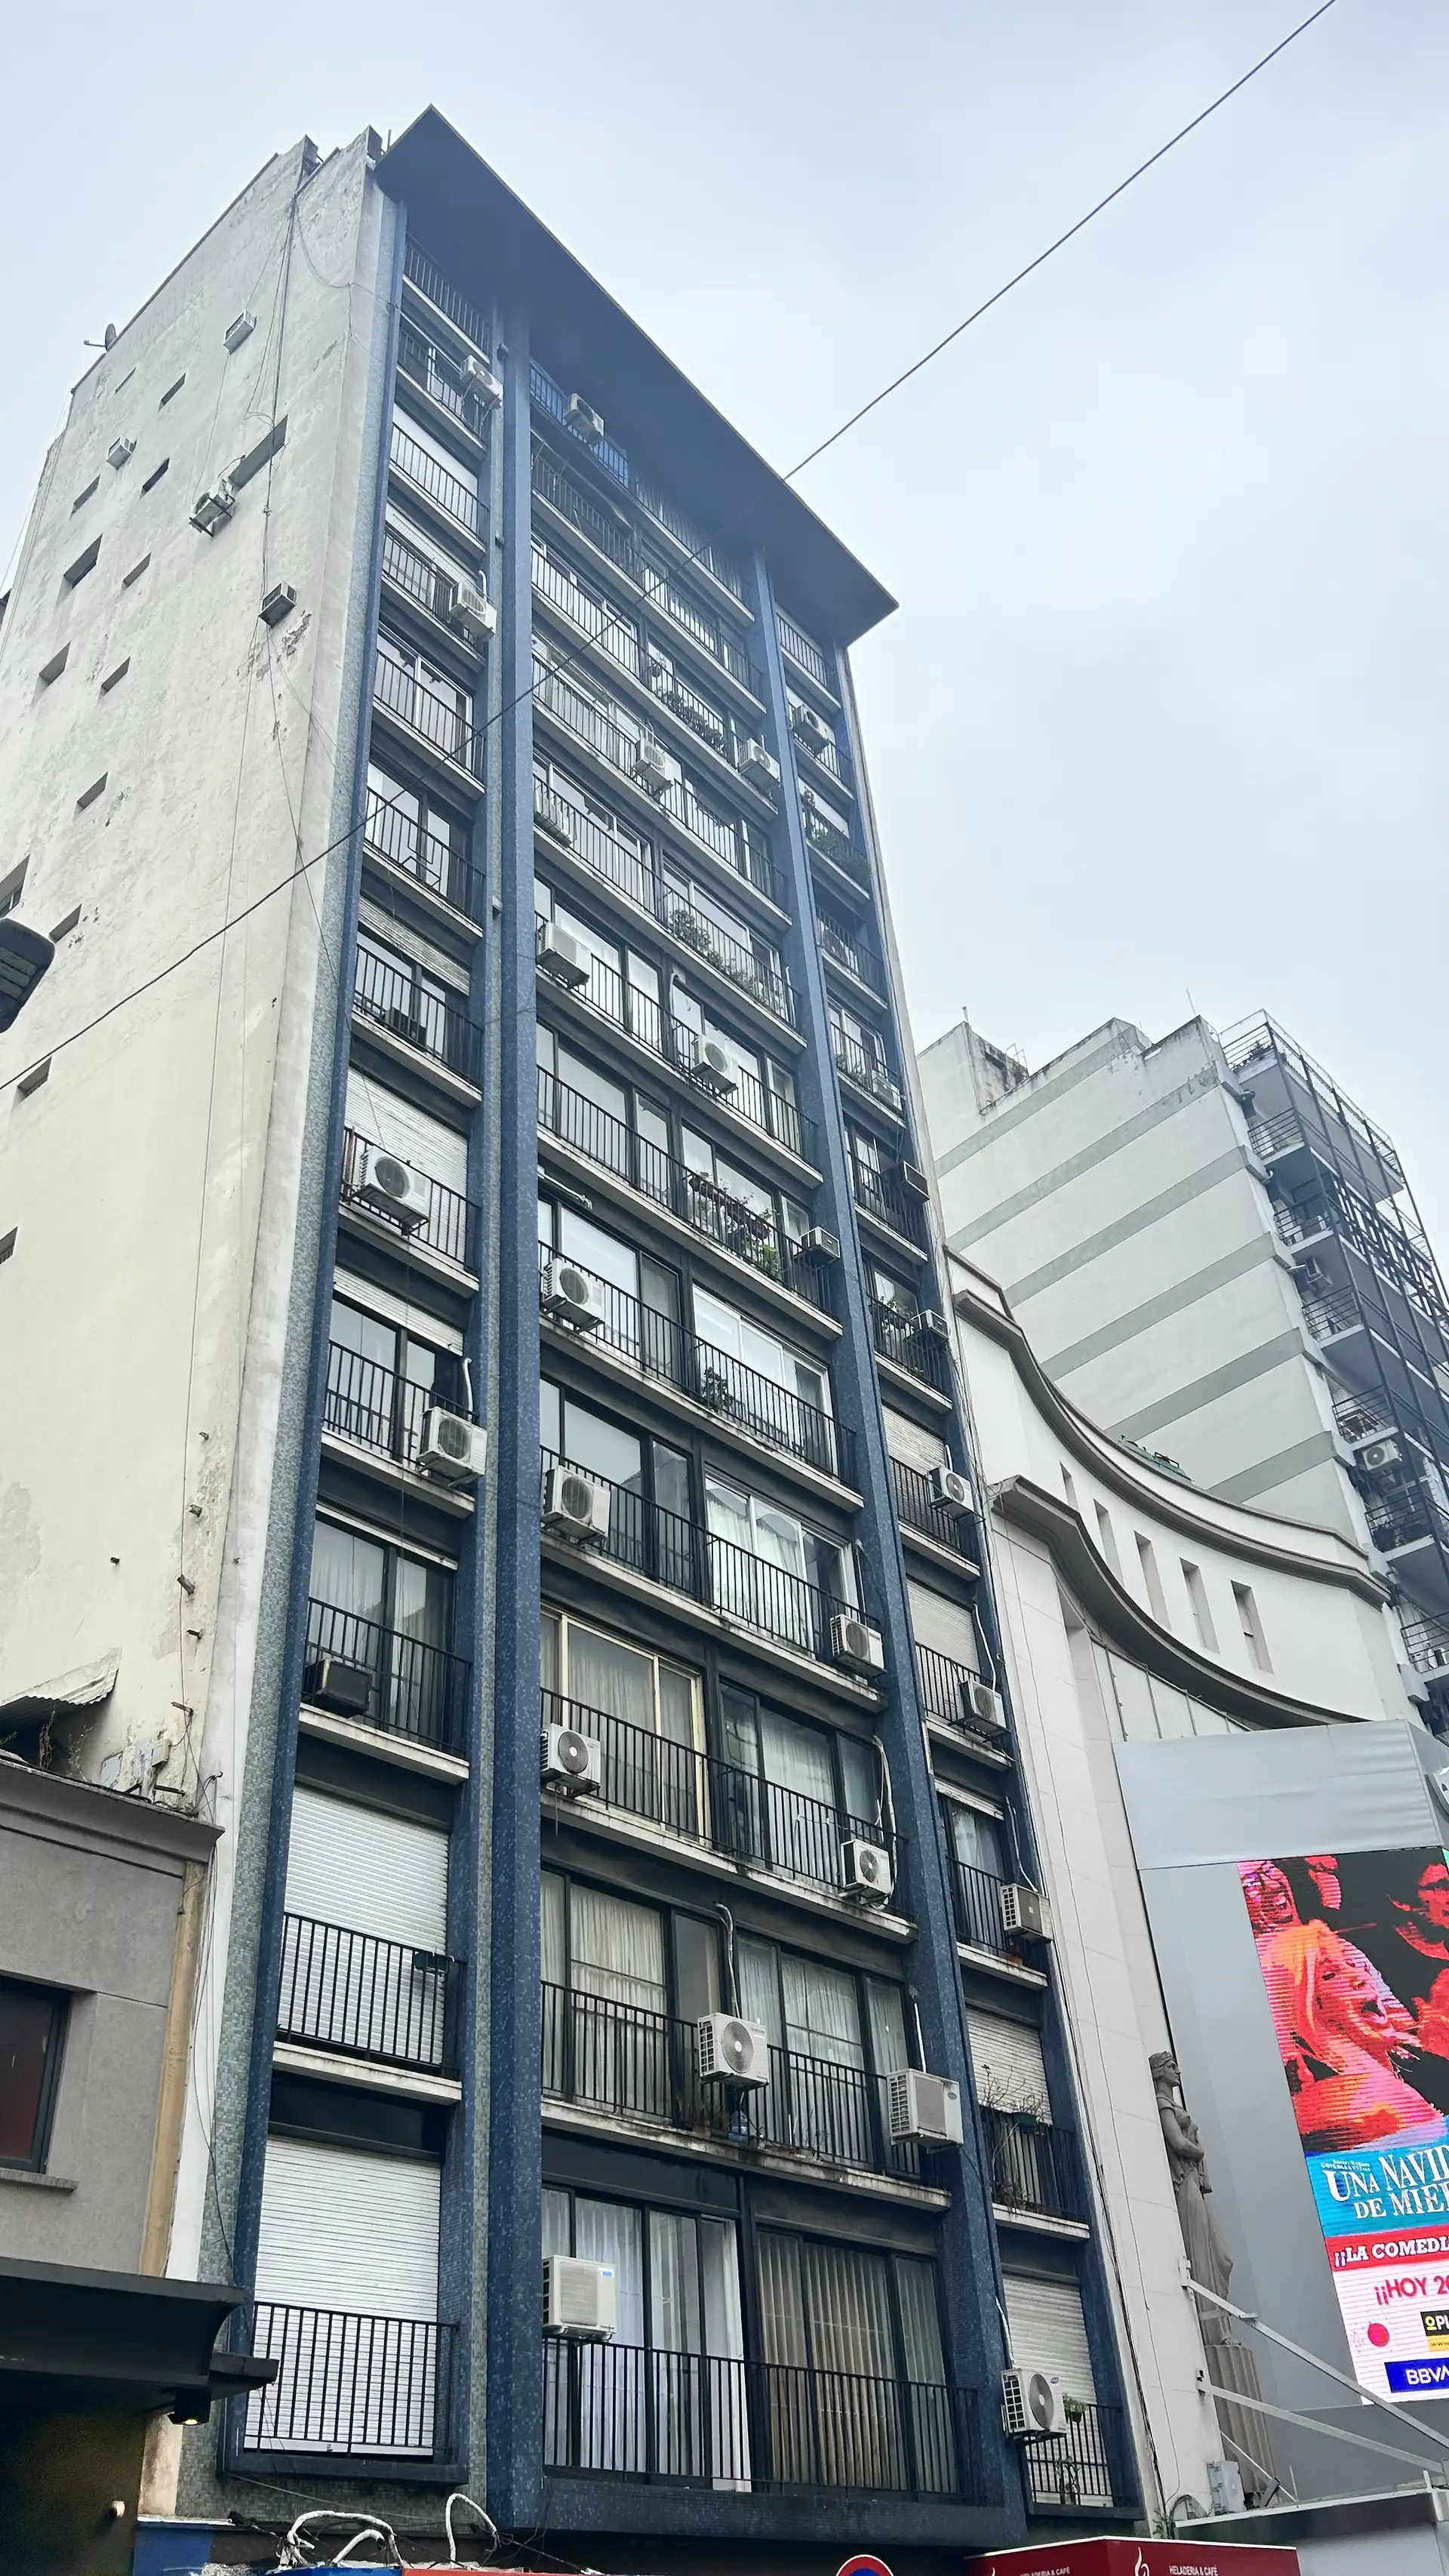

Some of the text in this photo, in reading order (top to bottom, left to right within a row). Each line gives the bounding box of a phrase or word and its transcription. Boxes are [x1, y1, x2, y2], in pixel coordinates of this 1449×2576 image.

[1322, 2170, 1380, 2202] UNA
[1354, 2198, 1386, 2219] DE
[1371, 2236, 1449, 2259] COMEDI
[1374, 2276, 1427, 2305] ¡¡HOY
[1056, 2566, 1070, 2576] CAFÉ
[1169, 2565, 1199, 2575] HELADERIA
[1204, 2565, 1218, 2576] CAFÉ
